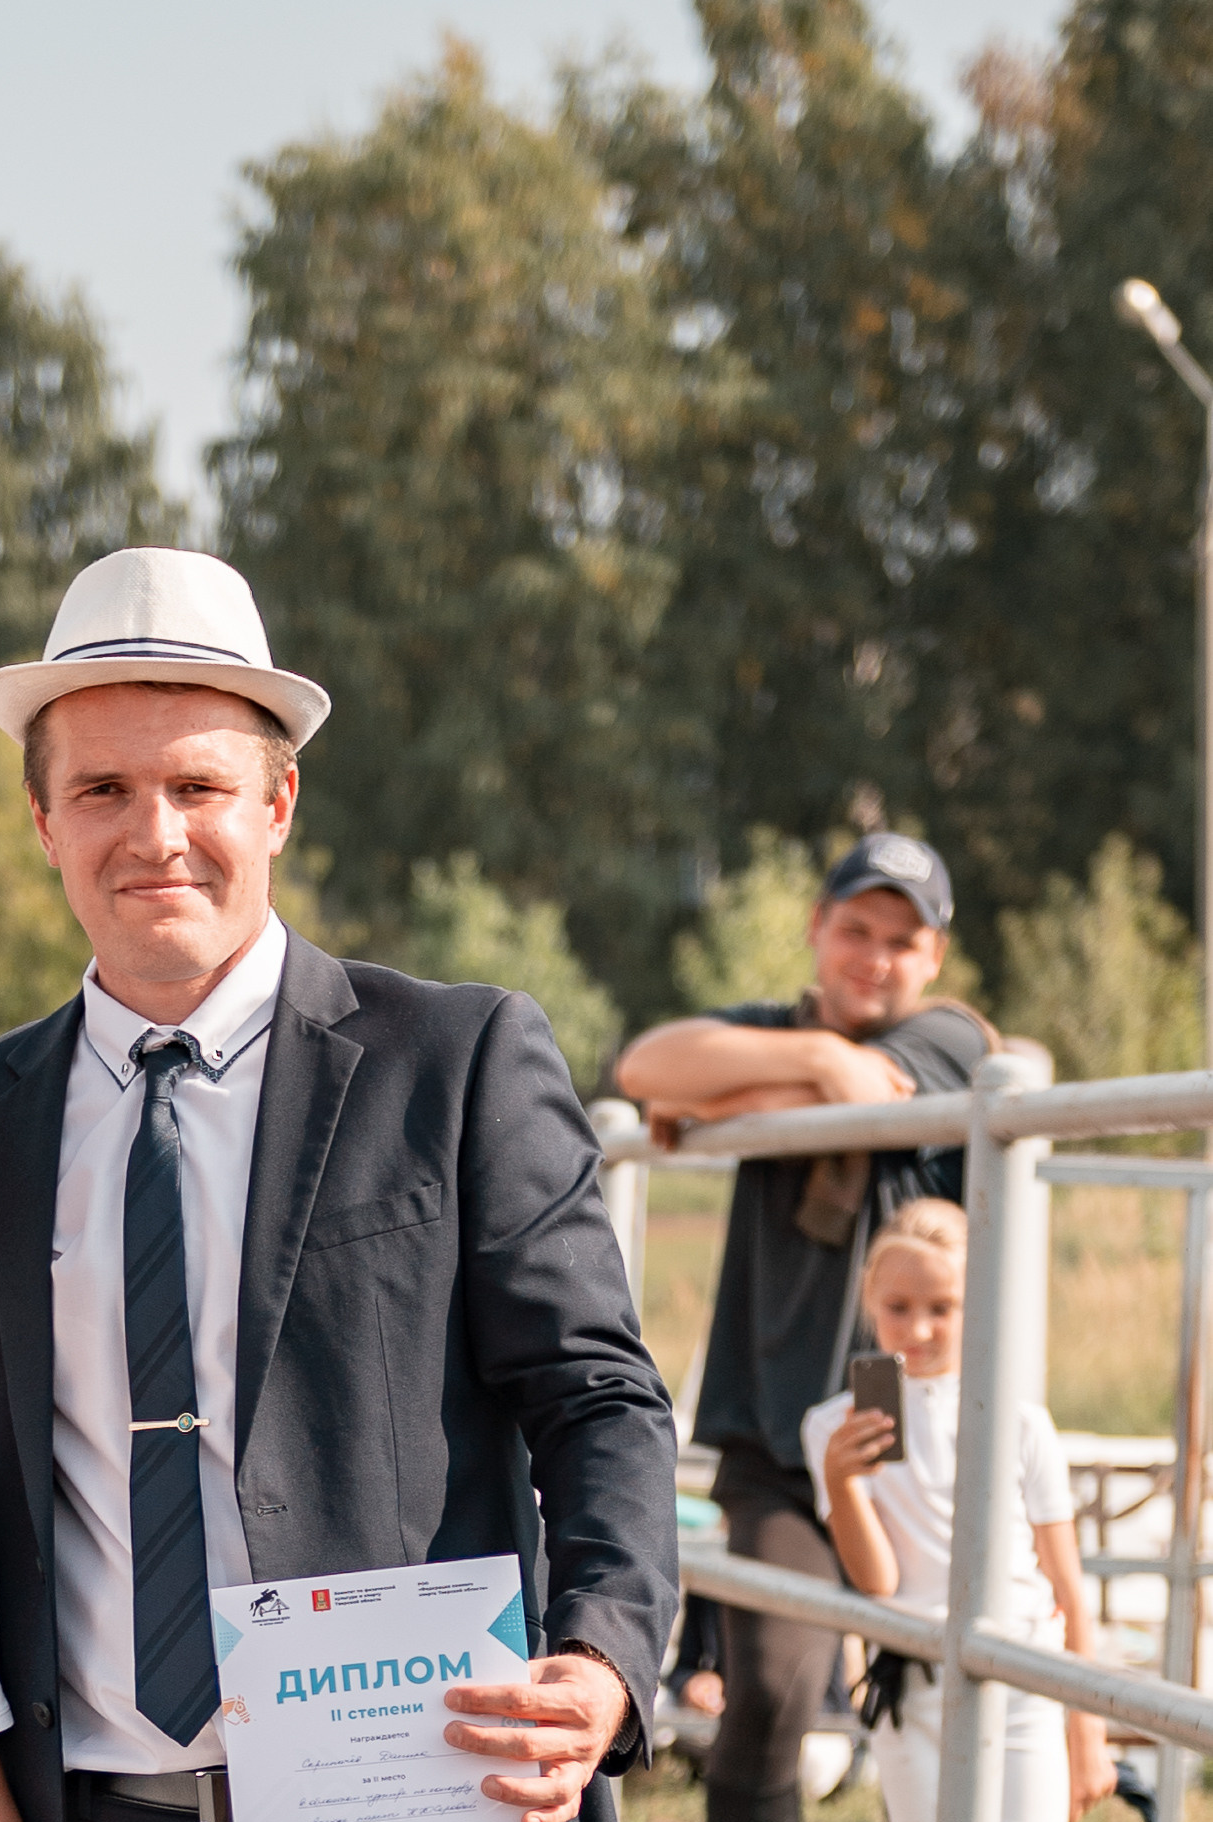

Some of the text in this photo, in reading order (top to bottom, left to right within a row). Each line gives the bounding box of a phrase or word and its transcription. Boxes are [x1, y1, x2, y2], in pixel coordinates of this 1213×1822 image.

[276, 1651, 473, 1704] ДИПЛОМ
[331, 1702, 424, 1723] II степени
[350, 1731, 410, 1743] Награждается
[380, 1773, 406, 1782] место
